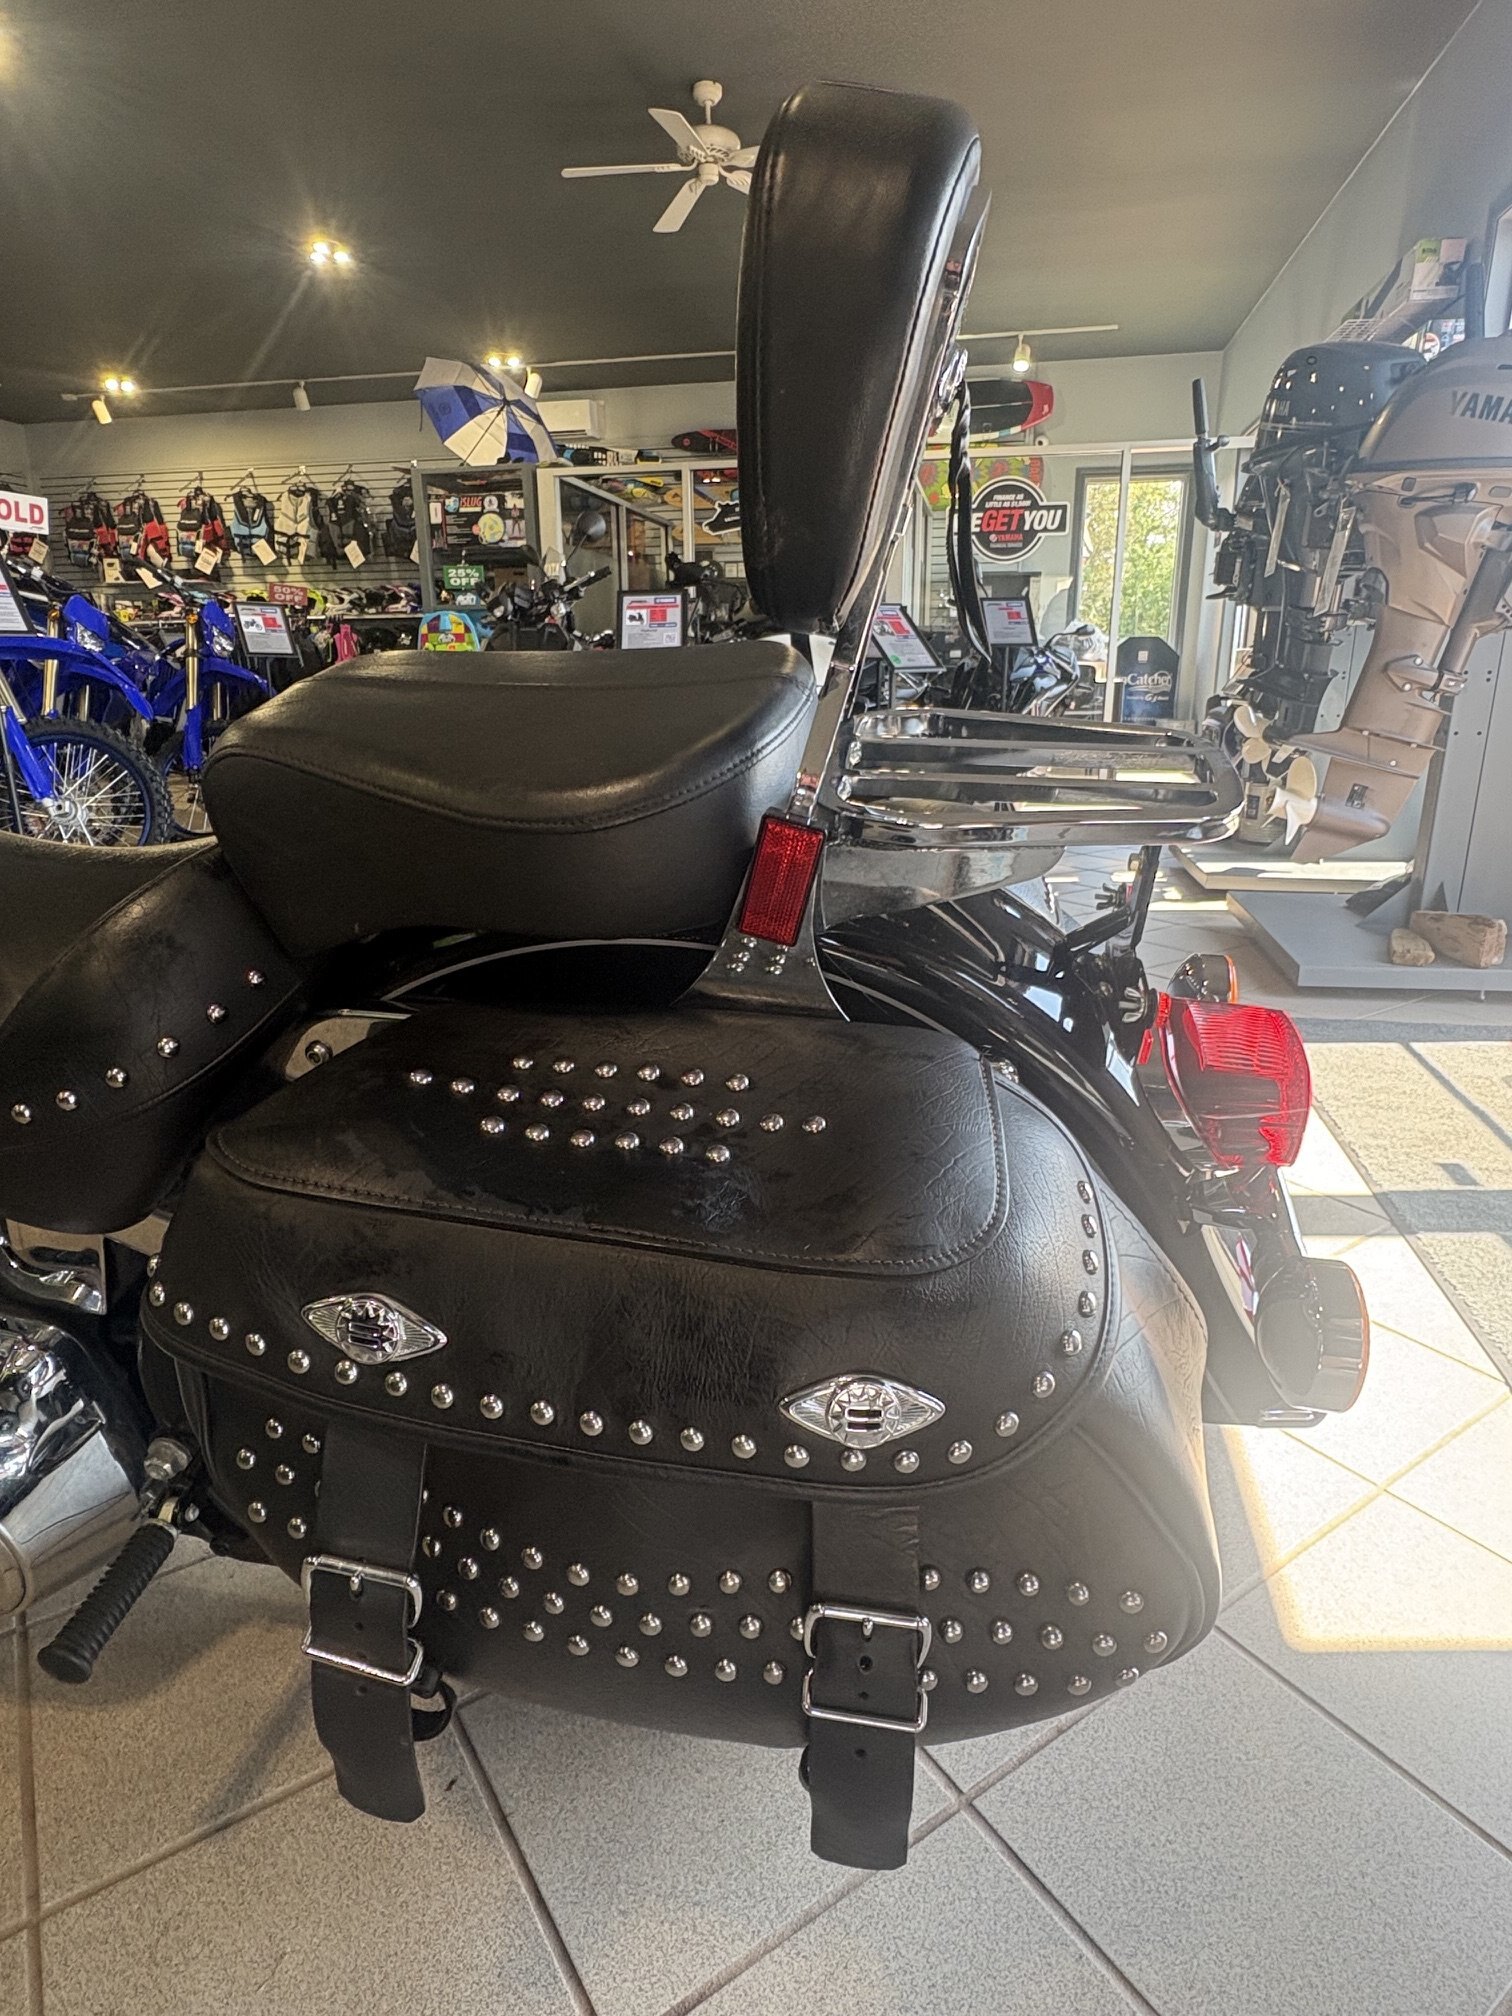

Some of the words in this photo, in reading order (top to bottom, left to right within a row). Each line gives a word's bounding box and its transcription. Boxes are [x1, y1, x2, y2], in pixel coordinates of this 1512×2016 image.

[981, 508, 1025, 533] GET
[1023, 509, 1062, 531] YOU
[997, 533, 1023, 542] YAMAHA
[448, 568, 480, 578] 25%
[449, 577, 480, 586] OFF
[273, 585, 304, 596] 50%
[274, 593, 303, 602] OFF
